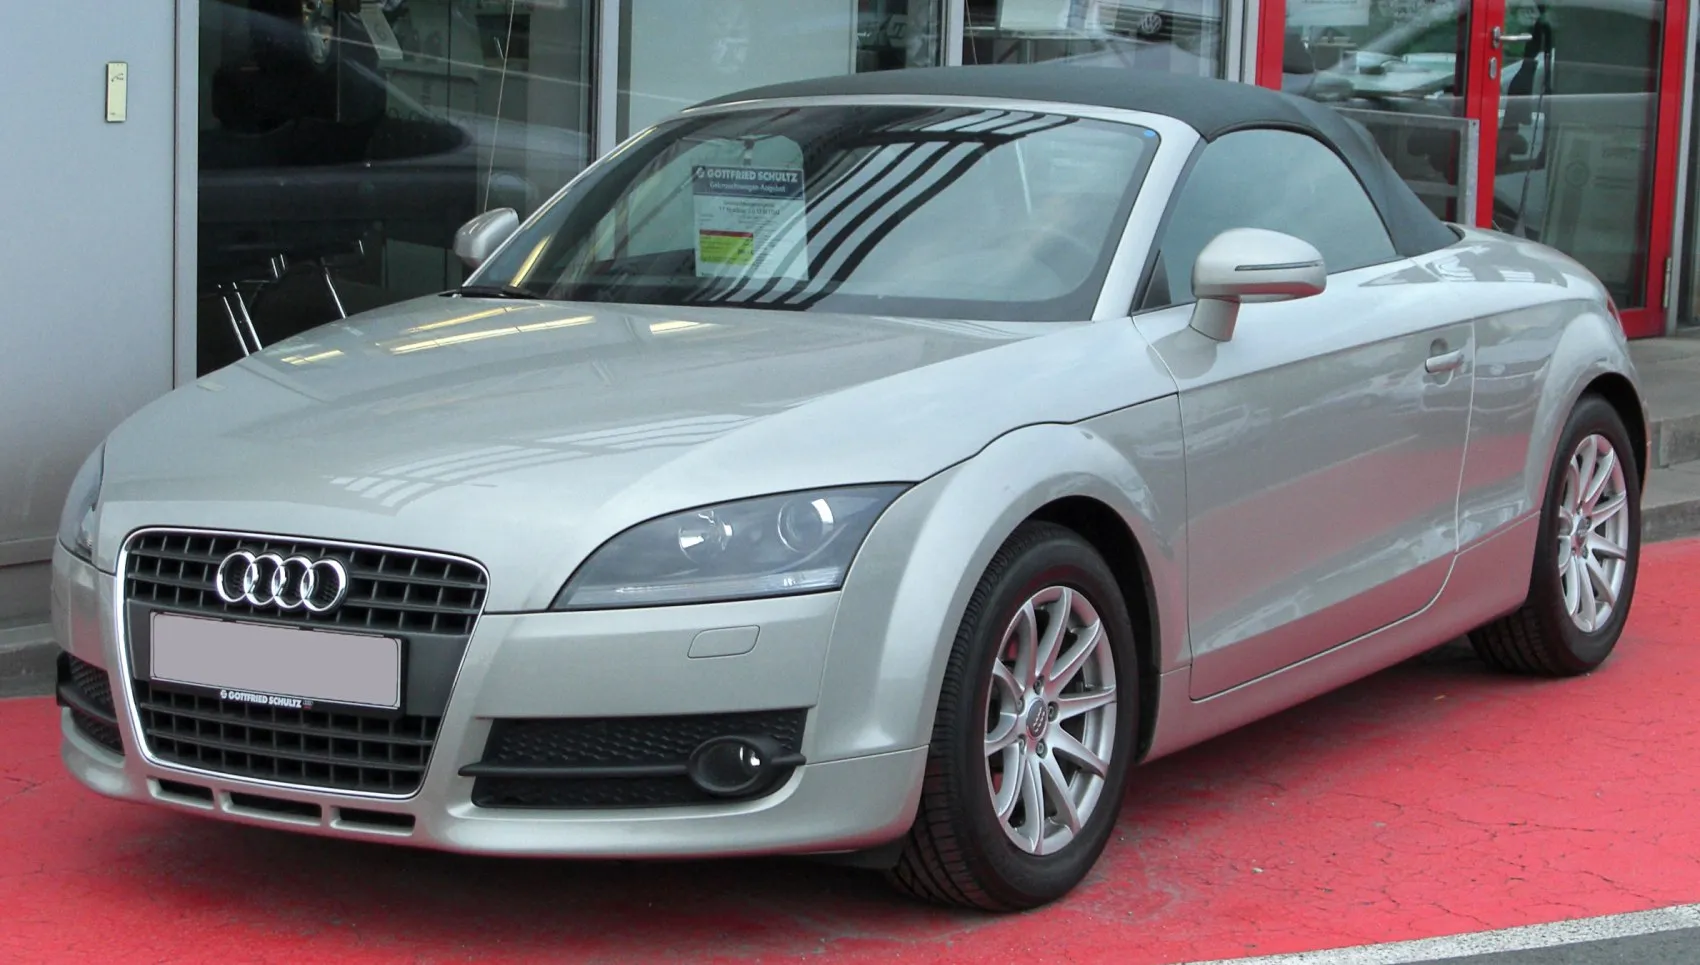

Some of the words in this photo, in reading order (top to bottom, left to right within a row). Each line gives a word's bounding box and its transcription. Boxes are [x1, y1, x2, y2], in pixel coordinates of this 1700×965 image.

[707, 169, 756, 181] GOTTFRIED
[757, 171, 798, 183] SCHULTZ
[228, 690, 268, 704] GOTTFRIED
[268, 696, 302, 708] SCHULTZ
